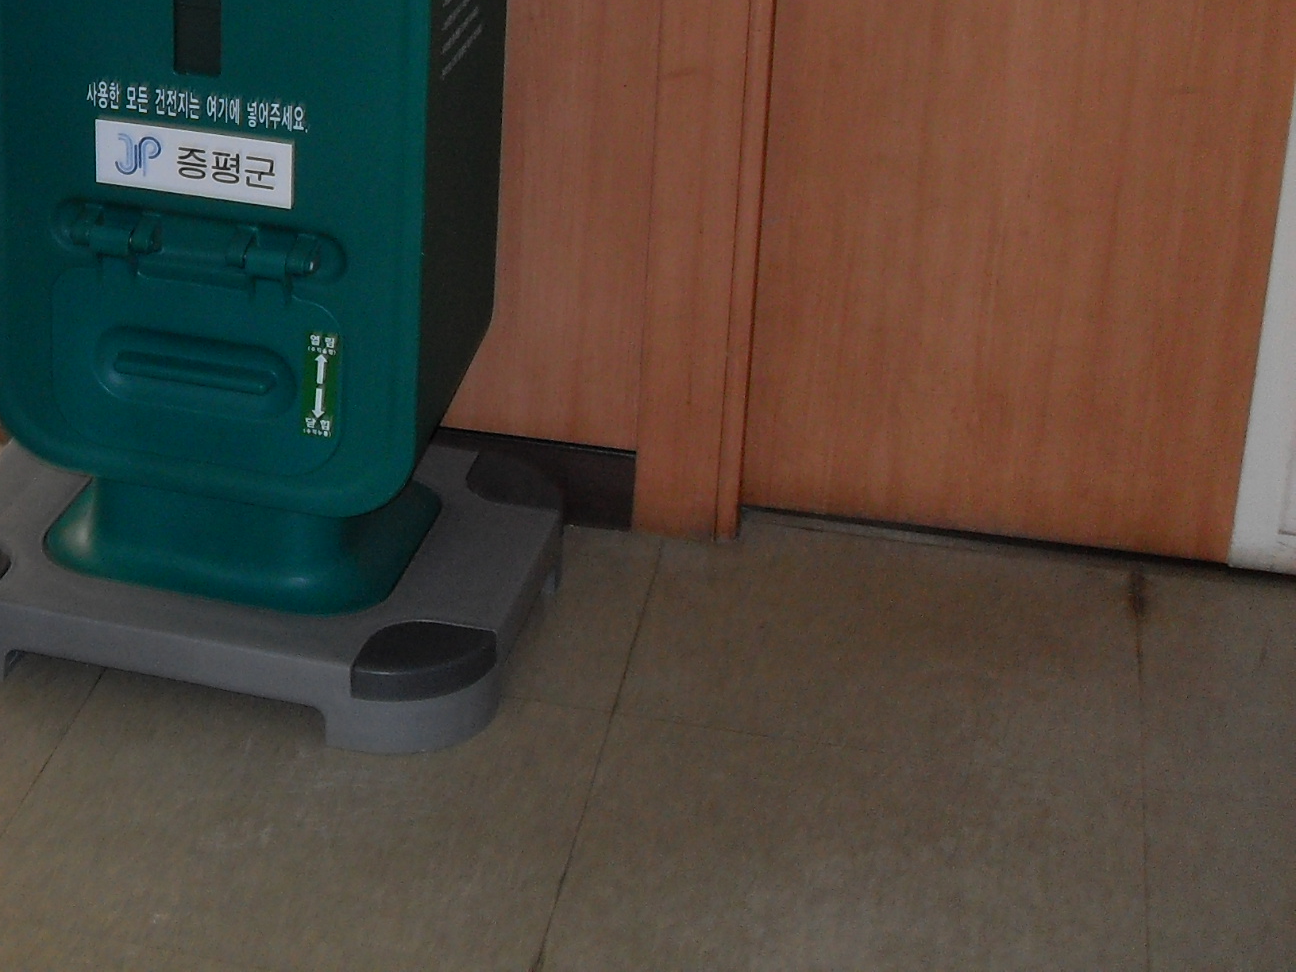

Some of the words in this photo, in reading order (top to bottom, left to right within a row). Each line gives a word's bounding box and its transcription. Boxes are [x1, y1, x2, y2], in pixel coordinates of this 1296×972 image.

[86, 81, 120, 110] 사용한
[125, 86, 149, 114] 모든
[154, 88, 200, 120] 건전지는
[206, 95, 240, 126] 여기에
[246, 101, 308, 134] 넣어주세요.
[176, 146, 276, 191] 증평군
